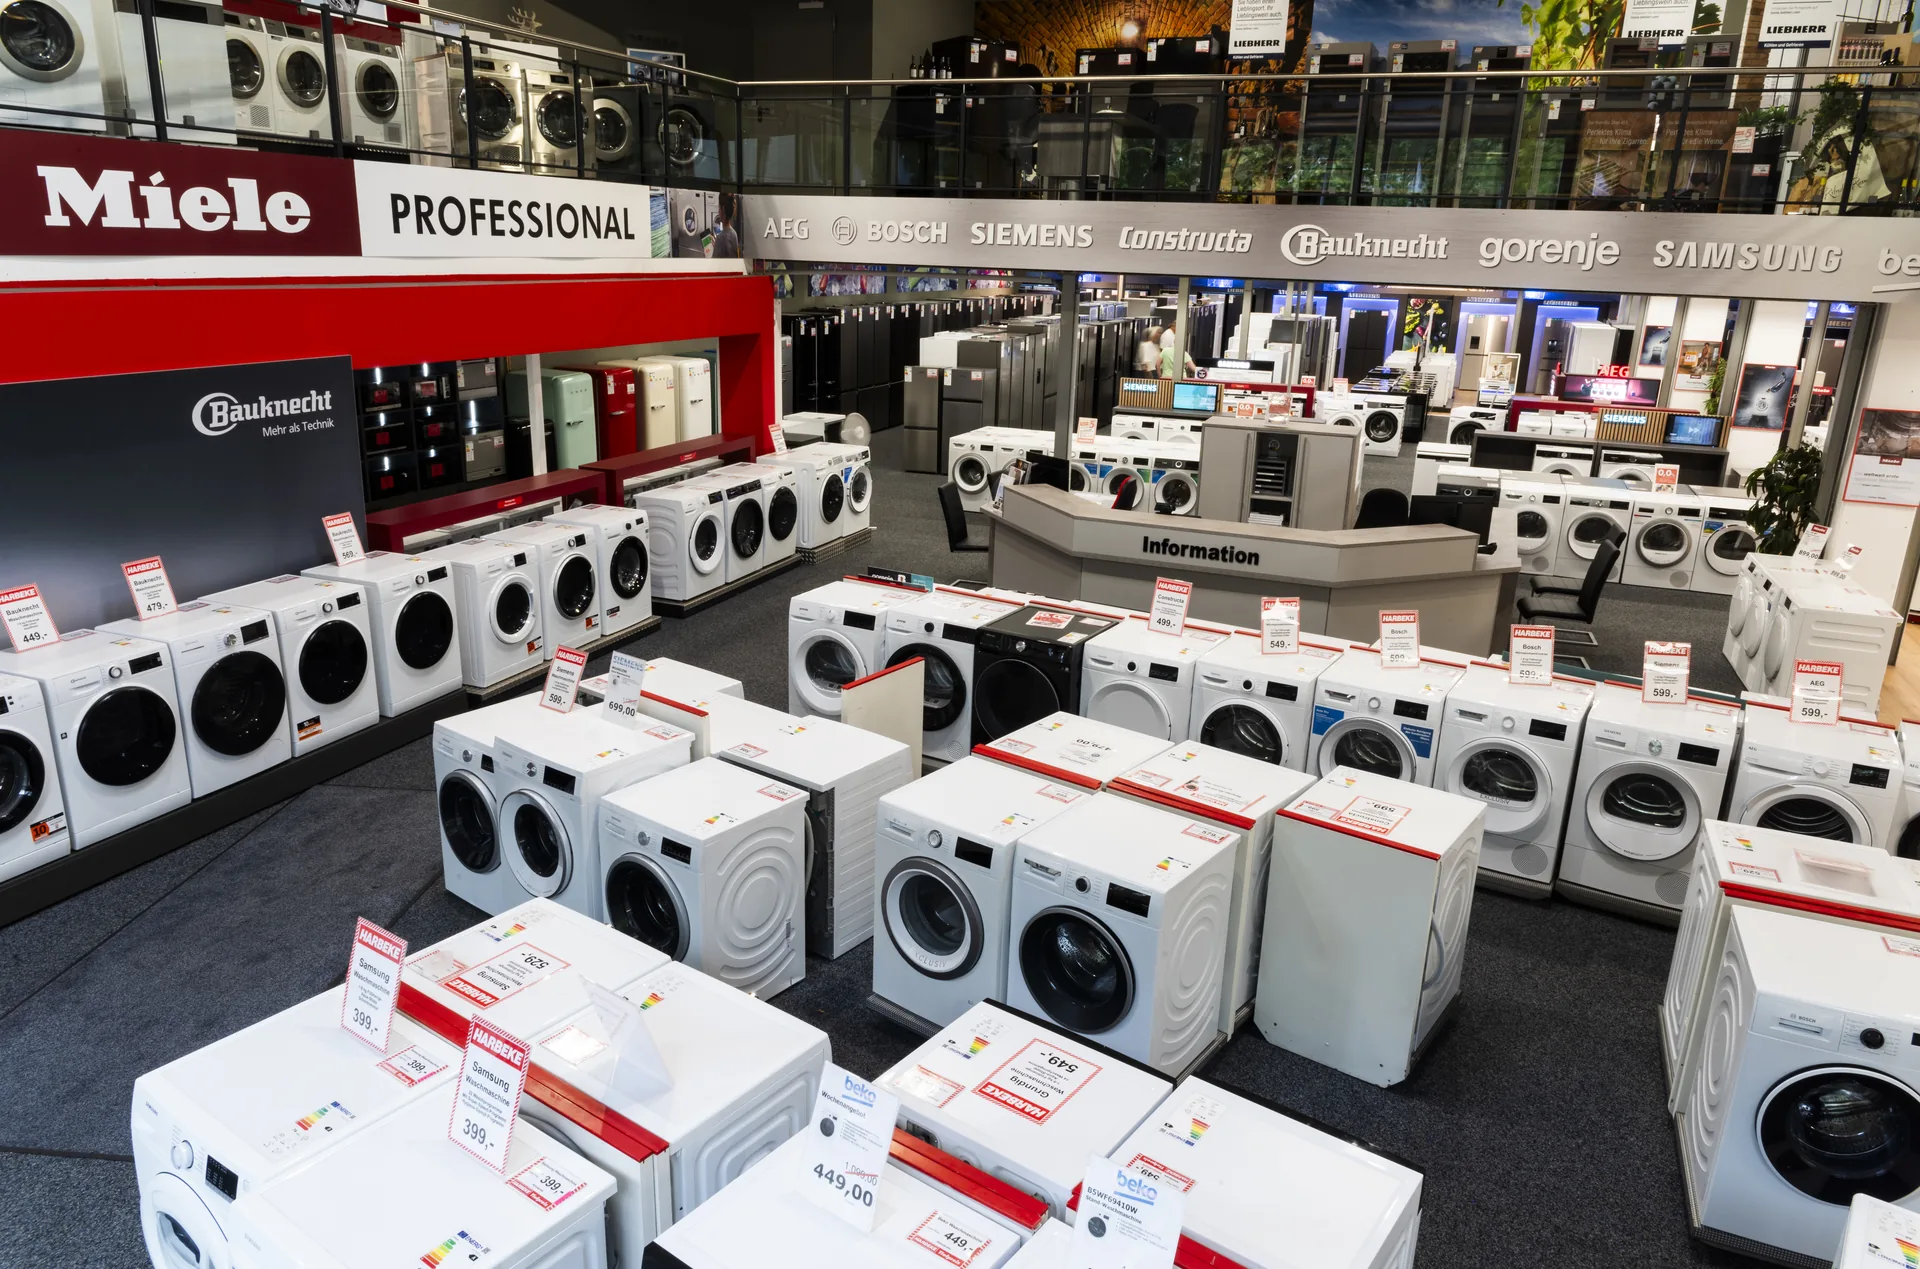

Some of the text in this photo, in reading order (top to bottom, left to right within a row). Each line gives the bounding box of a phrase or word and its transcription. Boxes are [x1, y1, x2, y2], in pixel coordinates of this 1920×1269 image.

[1627, 29, 1684, 38] LIEBHERR
[1766, 25, 1827, 34] LIEBHERR
[1233, 39, 1280, 48] LIEBHERR
[37, 165, 311, 233] Miele
[390, 193, 636, 240] PROFESSIONAL
[764, 217, 810, 240] AEG
[867, 220, 949, 245] BOSCH
[970, 222, 1094, 249] SIEMENS
[1118, 225, 1254, 254] Constructa
[1288, 228, 1449, 262] Bauknecht
[1478, 232, 1620, 272] gorenje
[1652, 239, 1844, 274] SAMSUNG
[1599, 365, 1631, 378] AEG
[1122, 382, 1158, 393] SIEMENS
[200, 389, 332, 431] Bauknecht
[262, 417, 335, 437] Mehr als Technik
[1603, 413, 1647, 425] SIEMENS
[1142, 535, 1260, 566] Information
[127, 561, 160, 574] HARBEKE
[133, 575, 162, 586] Bauknecht
[1158, 582, 1188, 593] HARBEKE
[6, 603, 40, 616] Bauknecht
[146, 602, 168, 612] 479,-
[1156, 617, 1176, 628] 499,-
[1382, 614, 1415, 622] HARBEKE
[23, 631, 48, 643] 449,-
[1514, 629, 1552, 638] HARBEKE
[1270, 640, 1291, 649] 549,-
[1522, 643, 1542, 651] Bosch
[557, 650, 585, 664] HARBEKE
[1797, 663, 1840, 674] HARBEKE
[548, 693, 566, 707] 599,-
[1653, 688, 1677, 698] 599,-
[608, 700, 636, 717] 699,00
[1801, 707, 1828, 718] 599,-
[33, 825, 47, 838] 10
[359, 928, 401, 960] HARBEKE
[520, 952, 550, 970] 529,-
[358, 957, 391, 984] Samsung
[353, 969, 391, 997] Waschmaschine
[476, 971, 511, 992] Samsung
[468, 979, 497, 1005] HARBEKE
[352, 1007, 379, 1035] 399,-
[1798, 1015, 1817, 1024] BOSCH
[473, 1028, 525, 1067] HARBEKE
[407, 1059, 428, 1075] 399,-
[1039, 1051, 1079, 1074] 549,-
[471, 1060, 511, 1094] Samsung
[1010, 1066, 1065, 1096] Waschmaschine
[465, 1074, 511, 1107] Waschmaschine
[844, 1075, 877, 1103] beko
[1009, 1075, 1050, 1099] Grundig
[820, 1089, 867, 1119] Wochenangebot
[983, 1083, 1047, 1117] HARBEKE
[462, 1117, 494, 1151] 399,-
[1135, 1165, 1161, 1181] 549,-
[540, 1175, 565, 1195] 399,-
[813, 1162, 873, 1208] 449,00
[1116, 1169, 1158, 1201] beko
[944, 1231, 974, 1252] 449,-
